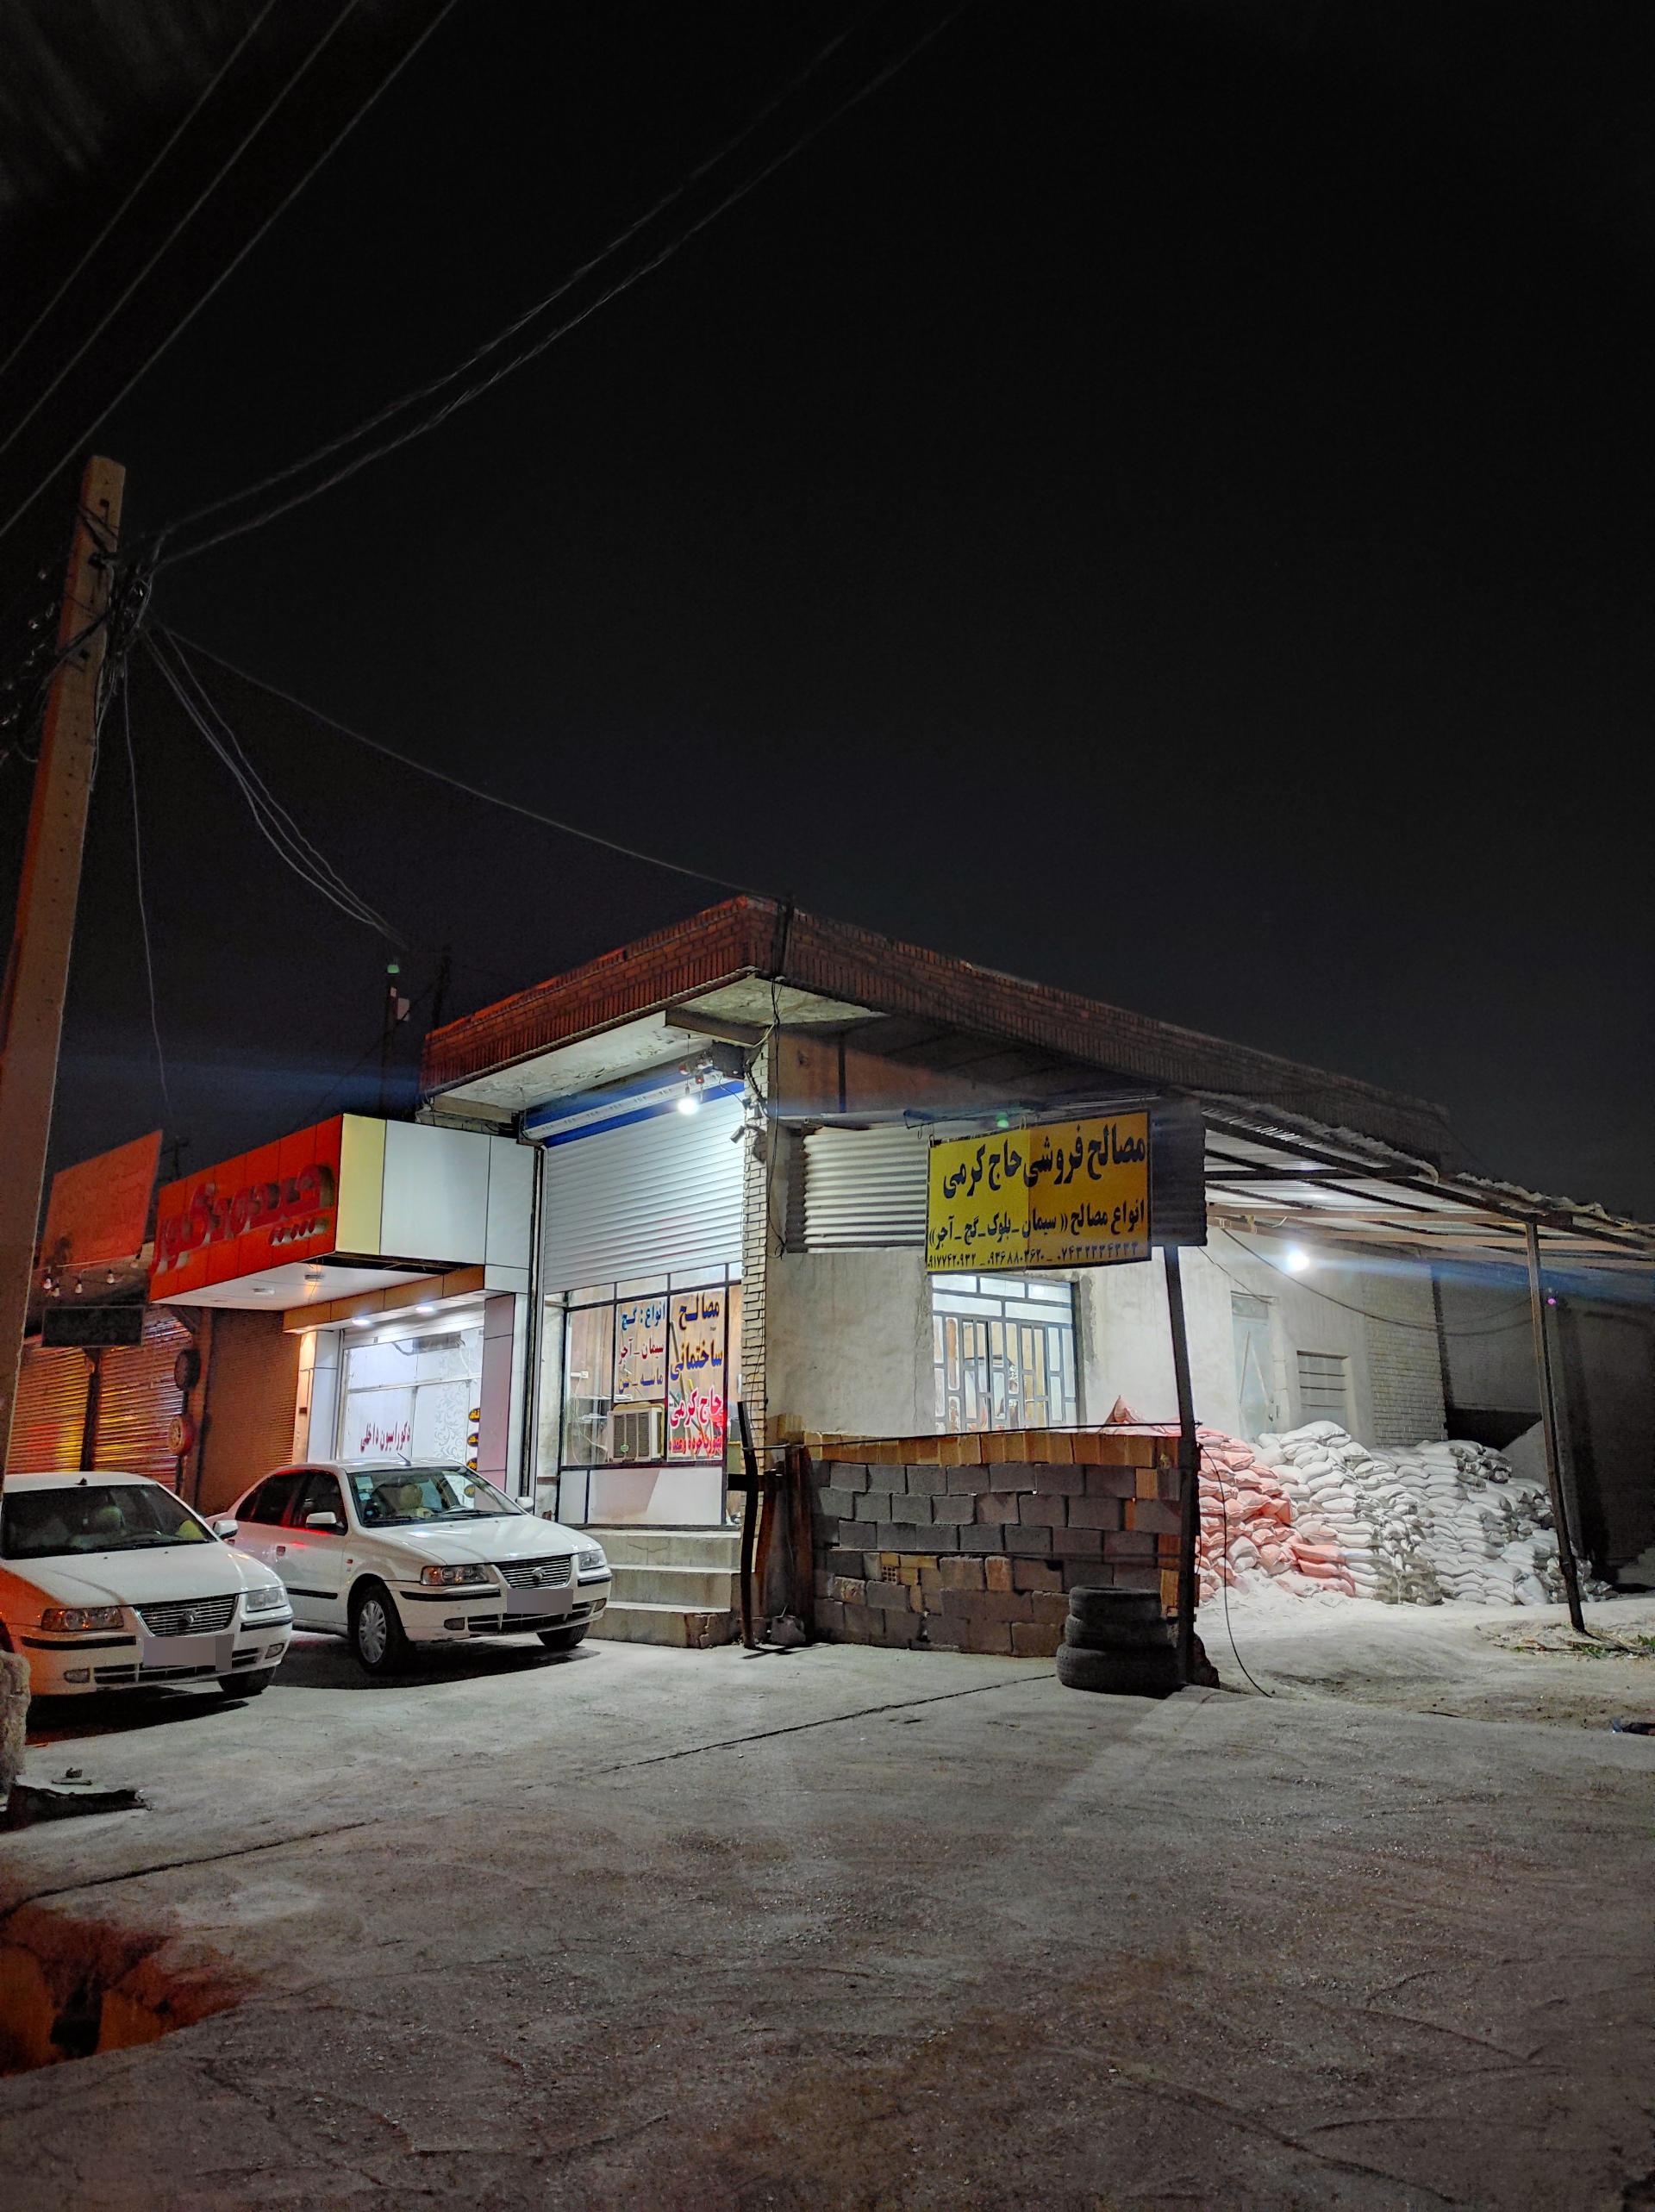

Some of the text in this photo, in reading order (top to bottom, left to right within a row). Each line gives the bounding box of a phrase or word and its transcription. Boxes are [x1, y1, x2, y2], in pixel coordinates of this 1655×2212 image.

[943, 1122, 1146, 1199] مصالح فروشی حاج کرمی
[987, 1211, 1011, 1243] بلوک
[1071, 1203, 1109, 1235] مصالح
[1110, 1197, 1145, 1234] انواع
[678, 1292, 721, 1330] مصالح
[641, 1335, 664, 1359] سیمان
[670, 1340, 723, 1381] ساختمانی
[640, 1366, 664, 1386] ماسه
[670, 1385, 723, 1428] حاج کرمی
